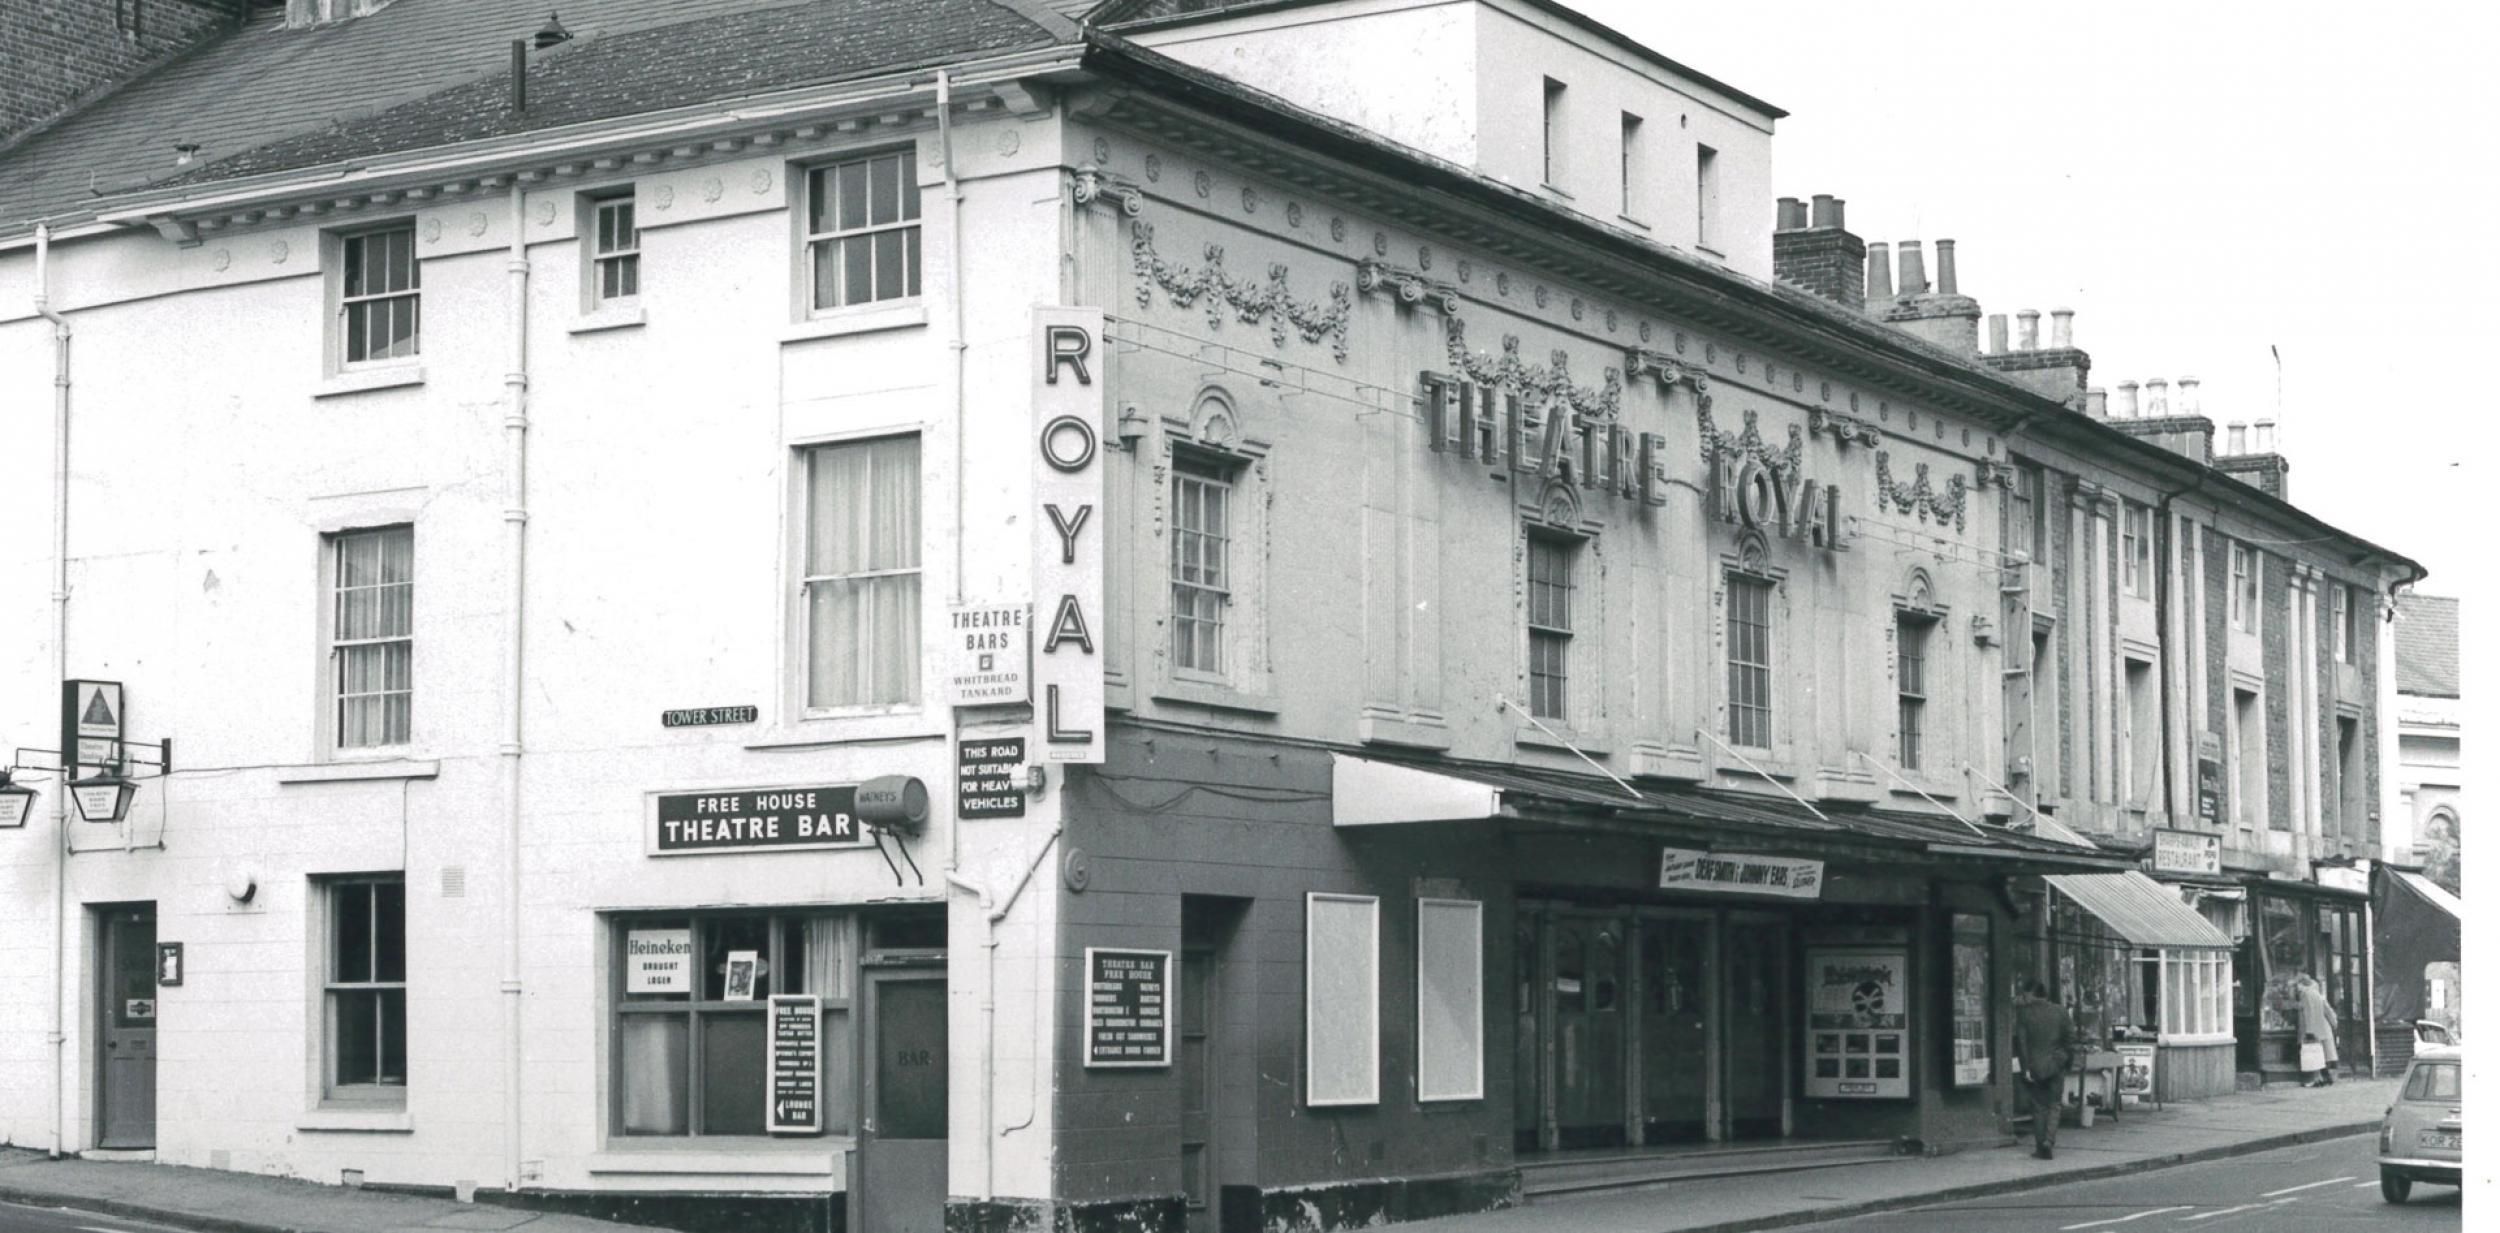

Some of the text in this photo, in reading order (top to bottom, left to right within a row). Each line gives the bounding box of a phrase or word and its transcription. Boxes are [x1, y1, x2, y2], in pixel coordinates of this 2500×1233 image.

[1419, 370, 1851, 552] THEATRE ROYAL
[1039, 325, 1096, 743] ROYAL
[952, 610, 1022, 629] THEATRE
[966, 633, 1009, 651] BARS
[953, 672, 1018, 686] WHITBREAD
[961, 686, 1013, 699] TANKARD
[666, 705, 755, 727] TOWER STREET
[964, 745, 1018, 759] THIS ROAD
[961, 764, 977, 777] NOT
[961, 779, 1011, 793] FOR HEAV
[697, 793, 816, 813] FREE HOUSE
[858, 790, 897, 803] WATNEYS
[963, 796, 1018, 810] VEHICLES
[665, 813, 850, 842] THEATRE BAR
[629, 940, 692, 955] Heineken
[643, 962, 678, 970] DRAUGHT
[647, 976, 671, 985] LAGER
[1104, 970, 1153, 980] FREE HOUSE
[775, 1007, 816, 1016] FREE HOUSE
[898, 1049, 930, 1067] BAR
[785, 1100, 812, 1110] LOUNGE
[792, 1111, 807, 1120] BAR
